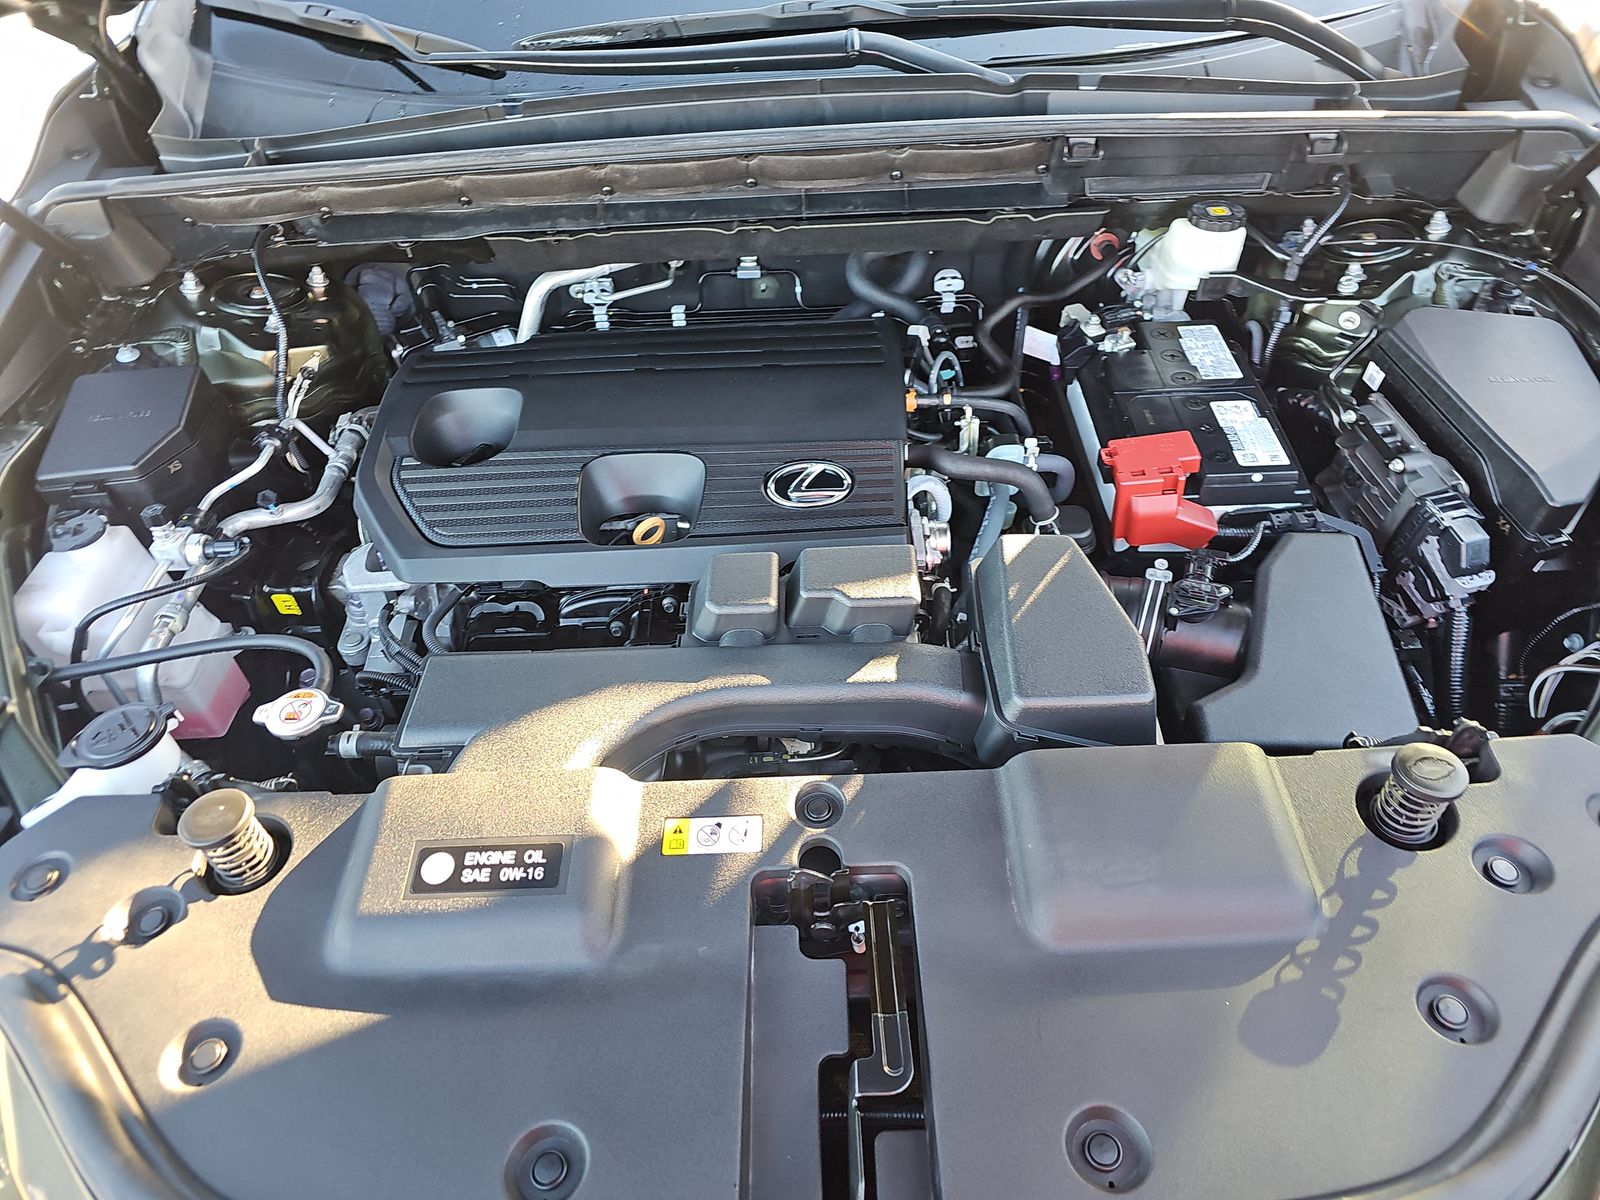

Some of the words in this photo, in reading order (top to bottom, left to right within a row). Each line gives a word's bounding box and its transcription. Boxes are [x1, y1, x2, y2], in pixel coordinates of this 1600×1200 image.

[464, 850, 517, 866] ENGINE
[523, 849, 547, 864] OIL
[461, 868, 491, 883] SAE
[499, 866, 545, 882] 0W-16
